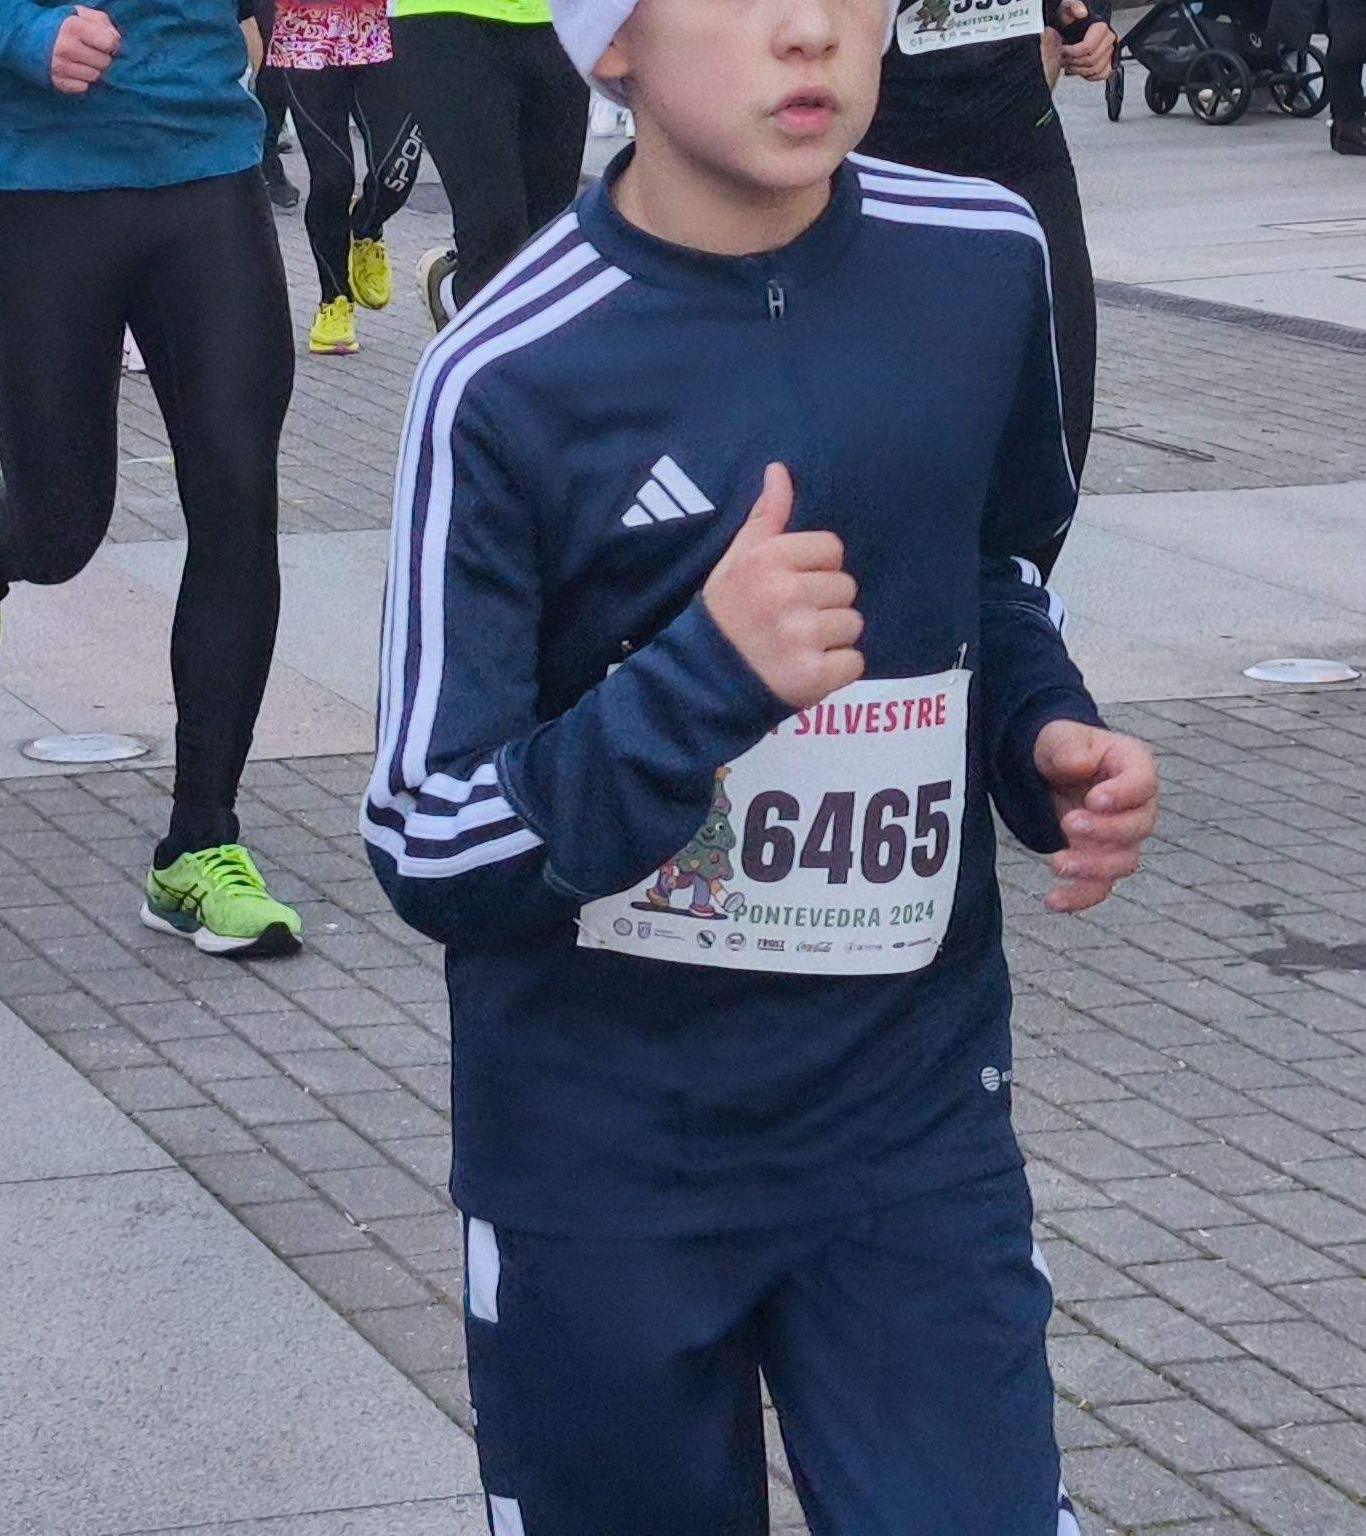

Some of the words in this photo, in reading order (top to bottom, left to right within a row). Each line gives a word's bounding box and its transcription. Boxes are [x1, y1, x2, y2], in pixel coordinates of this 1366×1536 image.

[794, 694, 946, 736] SILVESTRE
[740, 780, 953, 885] 6465
[734, 904, 881, 929] PONTEVEDRA
[889, 899, 936, 926] 2024
